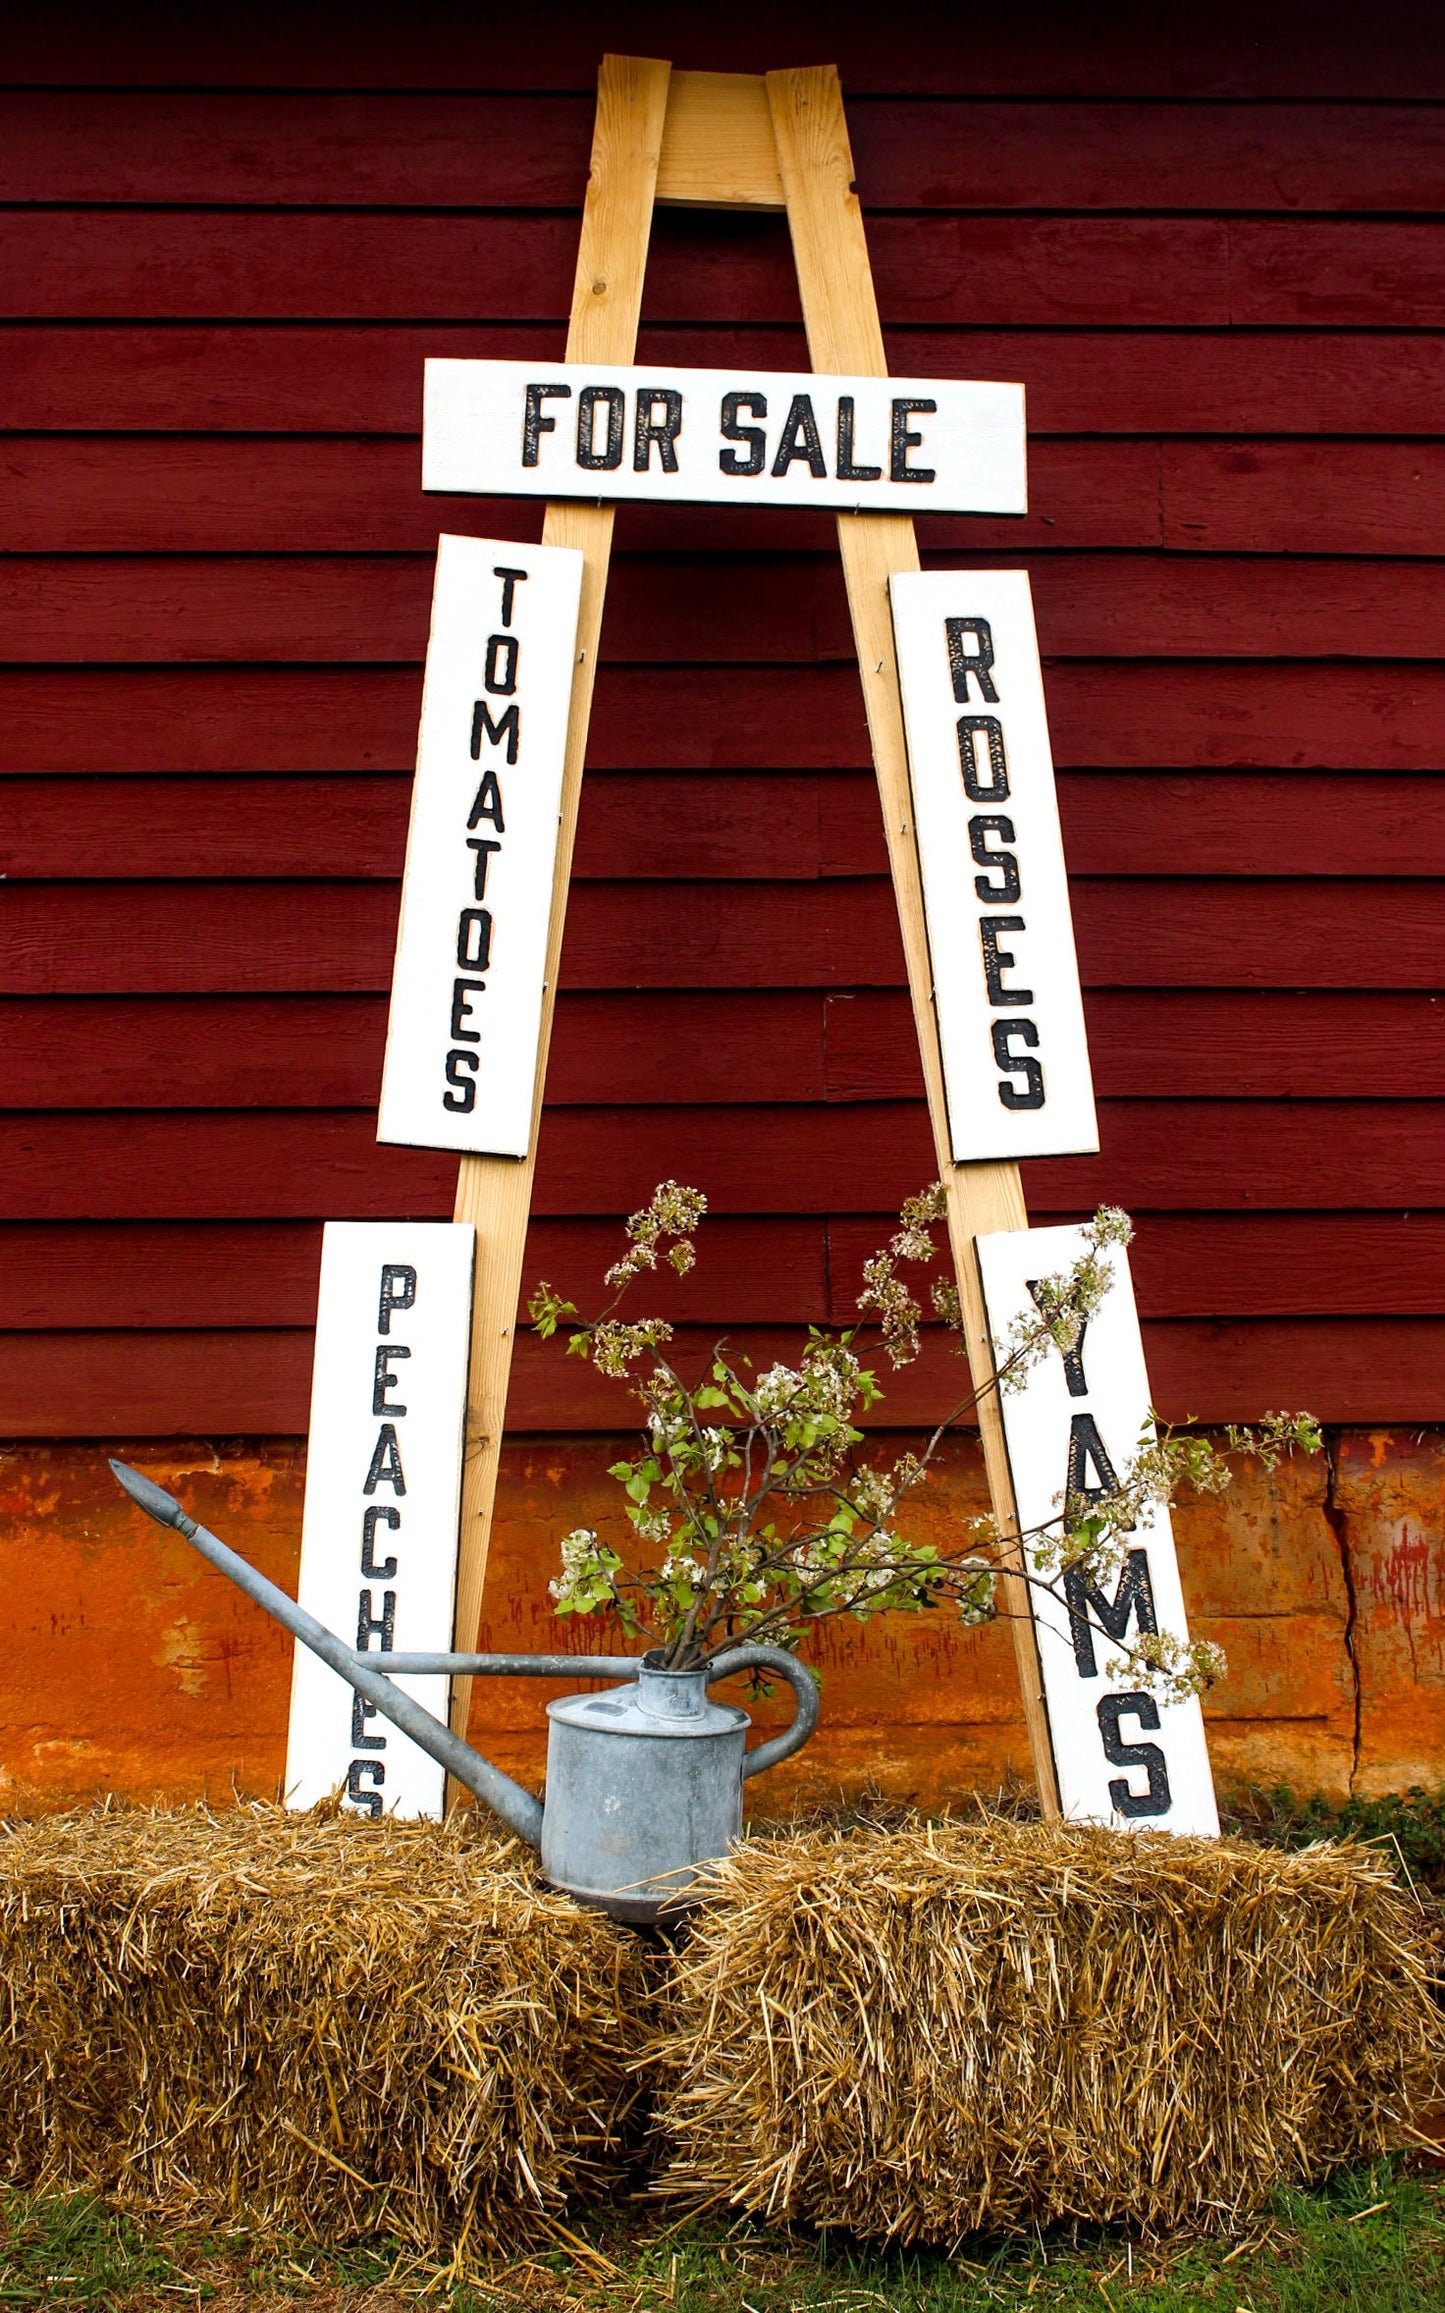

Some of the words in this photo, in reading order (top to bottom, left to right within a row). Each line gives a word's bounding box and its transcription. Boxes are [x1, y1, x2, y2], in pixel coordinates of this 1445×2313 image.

[521, 384, 683, 472] FOR
[719, 391, 938, 483] SALE
[442, 566, 528, 1114] TOMATOES
[944, 617, 1046, 1111] ROSES
[1025, 1277, 1173, 1818] YAMS
